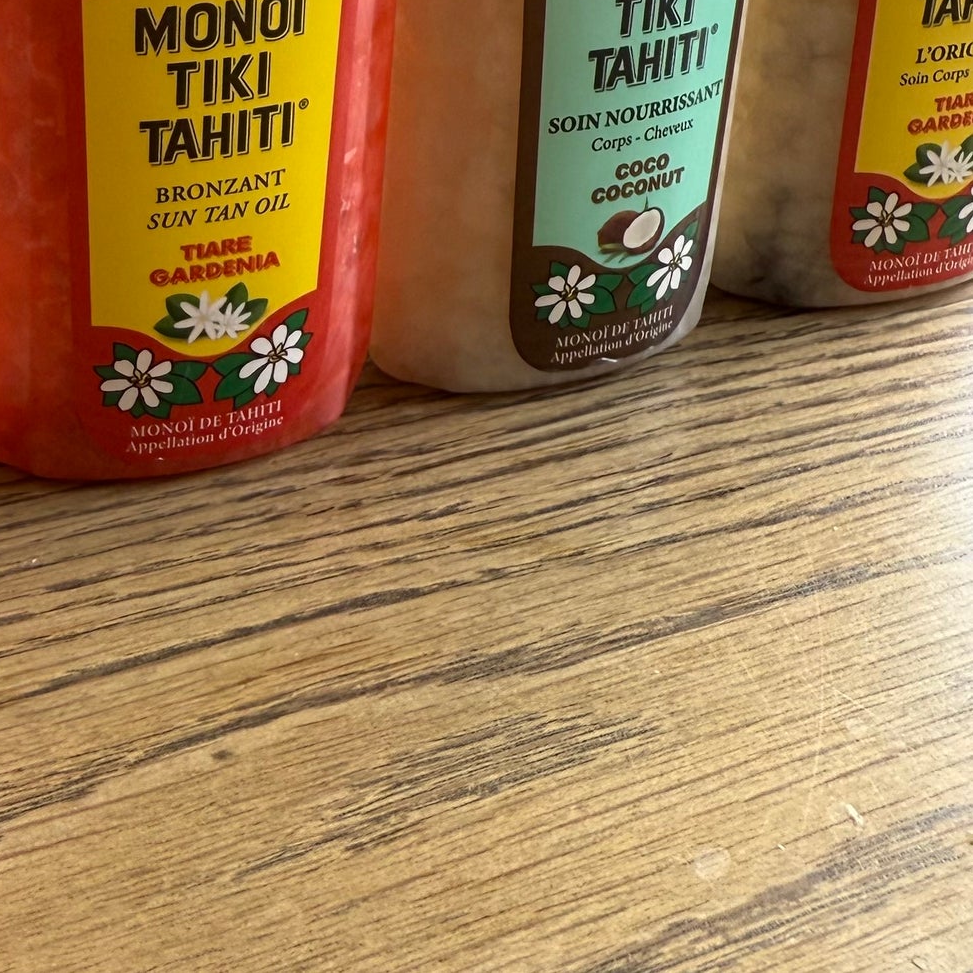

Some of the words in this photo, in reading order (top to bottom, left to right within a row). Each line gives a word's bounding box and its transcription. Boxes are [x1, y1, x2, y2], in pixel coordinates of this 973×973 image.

[167, 51, 271, 108] TIKI
[900, 72, 928, 86] Soin
[933, 69, 969, 83] Corps
[548, 113, 601, 134] SOIN
[605, 80, 723, 128] NOURRISSANT
[907, 111, 973, 135] GARDE
[592, 134, 632, 152] Corps
[645, 118, 694, 142] Cheveux
[615, 153, 670, 180] COCO
[155, 169, 285, 204] BRONZANT
[592, 168, 685, 204] COCONUT
[147, 209, 196, 230] SUN
[204, 201, 249, 223] TAN
[255, 193, 290, 214] OIL
[180, 235, 253, 262] TIARE
[924, 251, 941, 264] DE
[149, 251, 280, 287] GARDENIA
[864, 268, 933, 287] Appellation
[612, 322, 629, 336] DE
[633, 305, 673, 329] TAHITI
[550, 340, 622, 364] Appellation
[626, 320, 673, 346] d'Origine
[126, 433, 214, 454] Appellation
[219, 416, 283, 440] d'Origine
[131, 417, 195, 437] MONOÏ
[200, 415, 221, 429] DE
[227, 400, 281, 424] TAHITI
